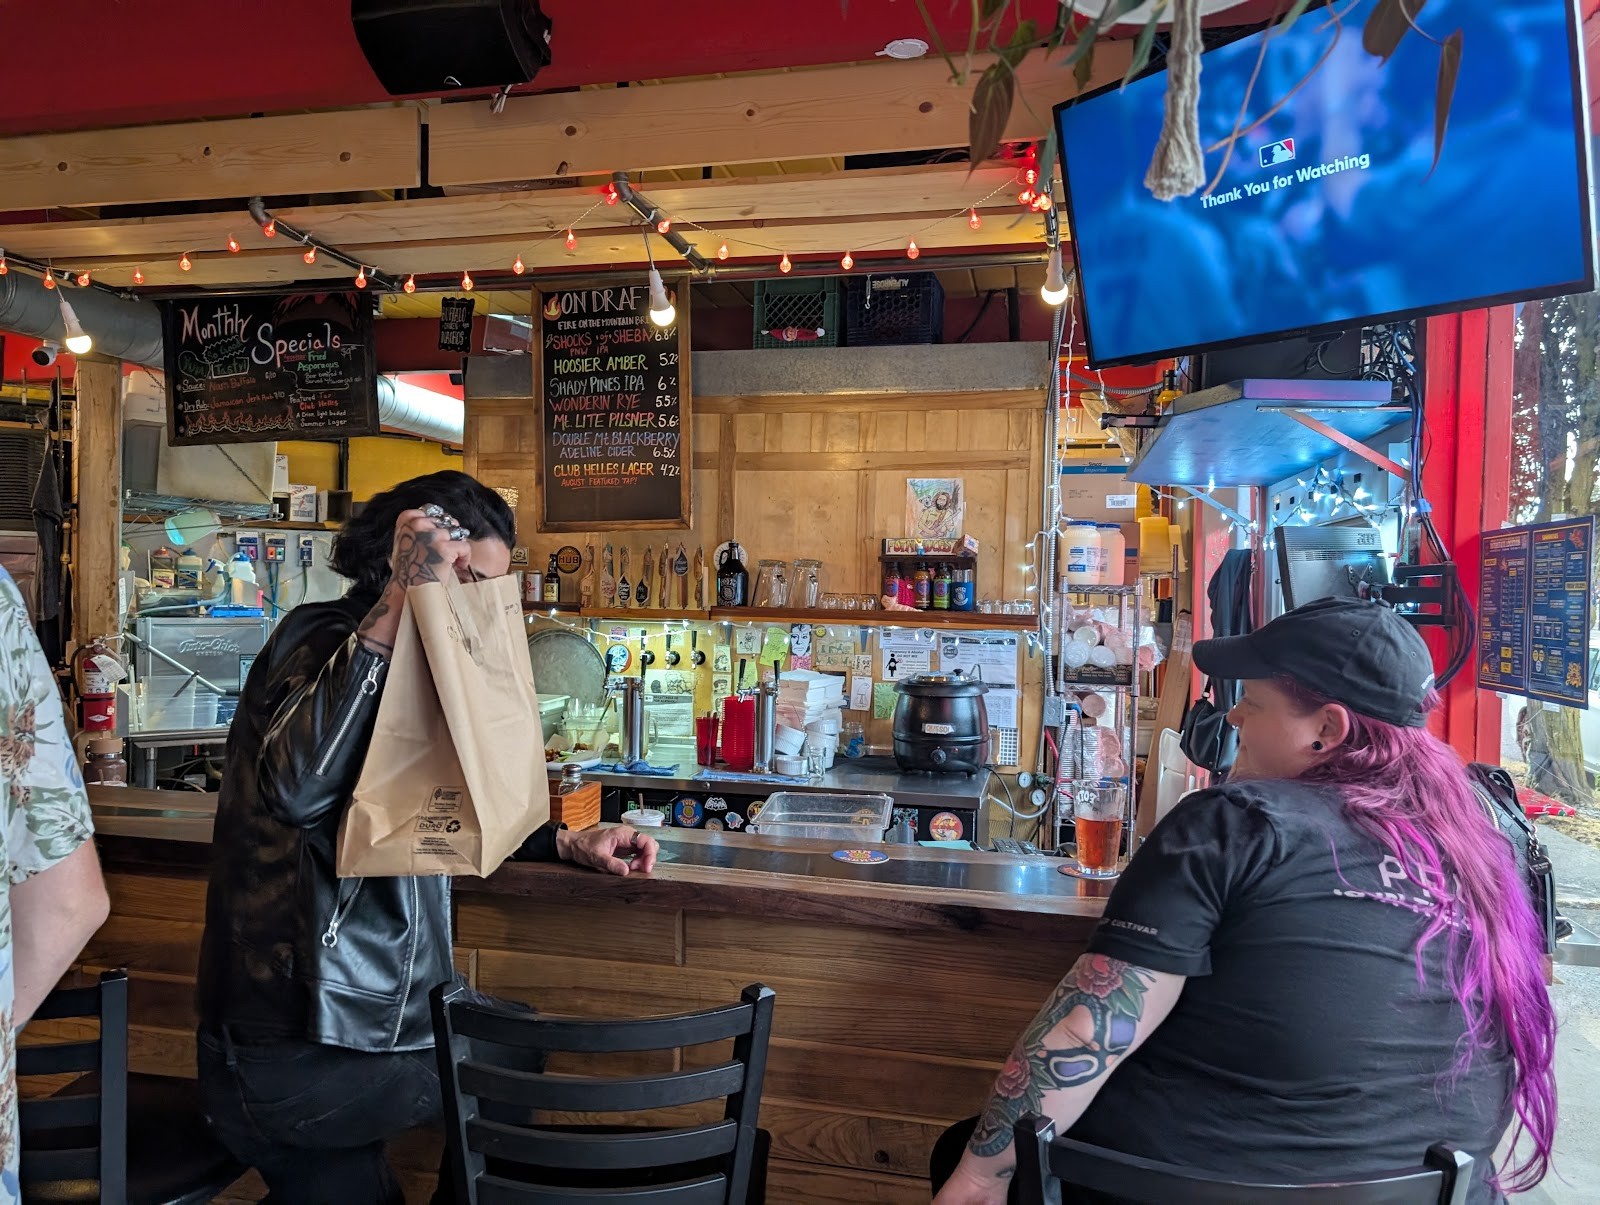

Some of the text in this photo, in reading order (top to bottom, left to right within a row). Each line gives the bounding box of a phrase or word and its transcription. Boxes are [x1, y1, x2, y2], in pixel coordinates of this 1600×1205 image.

[1200, 153, 1370, 209] Thank You for Watching
[561, 291, 587, 314] ON
[179, 304, 253, 344] Monthly
[557, 320, 577, 330] FIRE
[601, 317, 635, 327] MOUNTAIN
[251, 322, 341, 368] Specials
[552, 332, 593, 350] SHOCKS
[612, 328, 651, 344] SHEBA
[308, 351, 327, 361] Fried
[570, 345, 609, 356] PNW IPA
[297, 361, 340, 375] Asparagus
[553, 356, 604, 375] HOOSIER
[605, 354, 649, 371] AMBER
[549, 377, 588, 398] SHADY
[589, 376, 621, 394] PINES
[624, 374, 646, 391] IPA
[288, 394, 316, 404] Featured
[616, 393, 642, 410] RYE
[300, 418, 347, 428] Summer Lager
[575, 413, 606, 428] LITE
[608, 412, 657, 428] PILSNER
[552, 432, 593, 447] DOUBLE
[611, 431, 681, 449] BLACKBERRY
[560, 446, 604, 459] ADELINE
[607, 445, 637, 457] CIDER
[553, 464, 581, 477] CLUB
[583, 463, 619, 476] HELLES
[620, 462, 655, 476] LAGER
[560, 478, 585, 488] AUGUST
[588, 477, 621, 487] FEATURED
[559, 555, 579, 564] HUB
[1111, 919, 1158, 936] CULTIVAR
